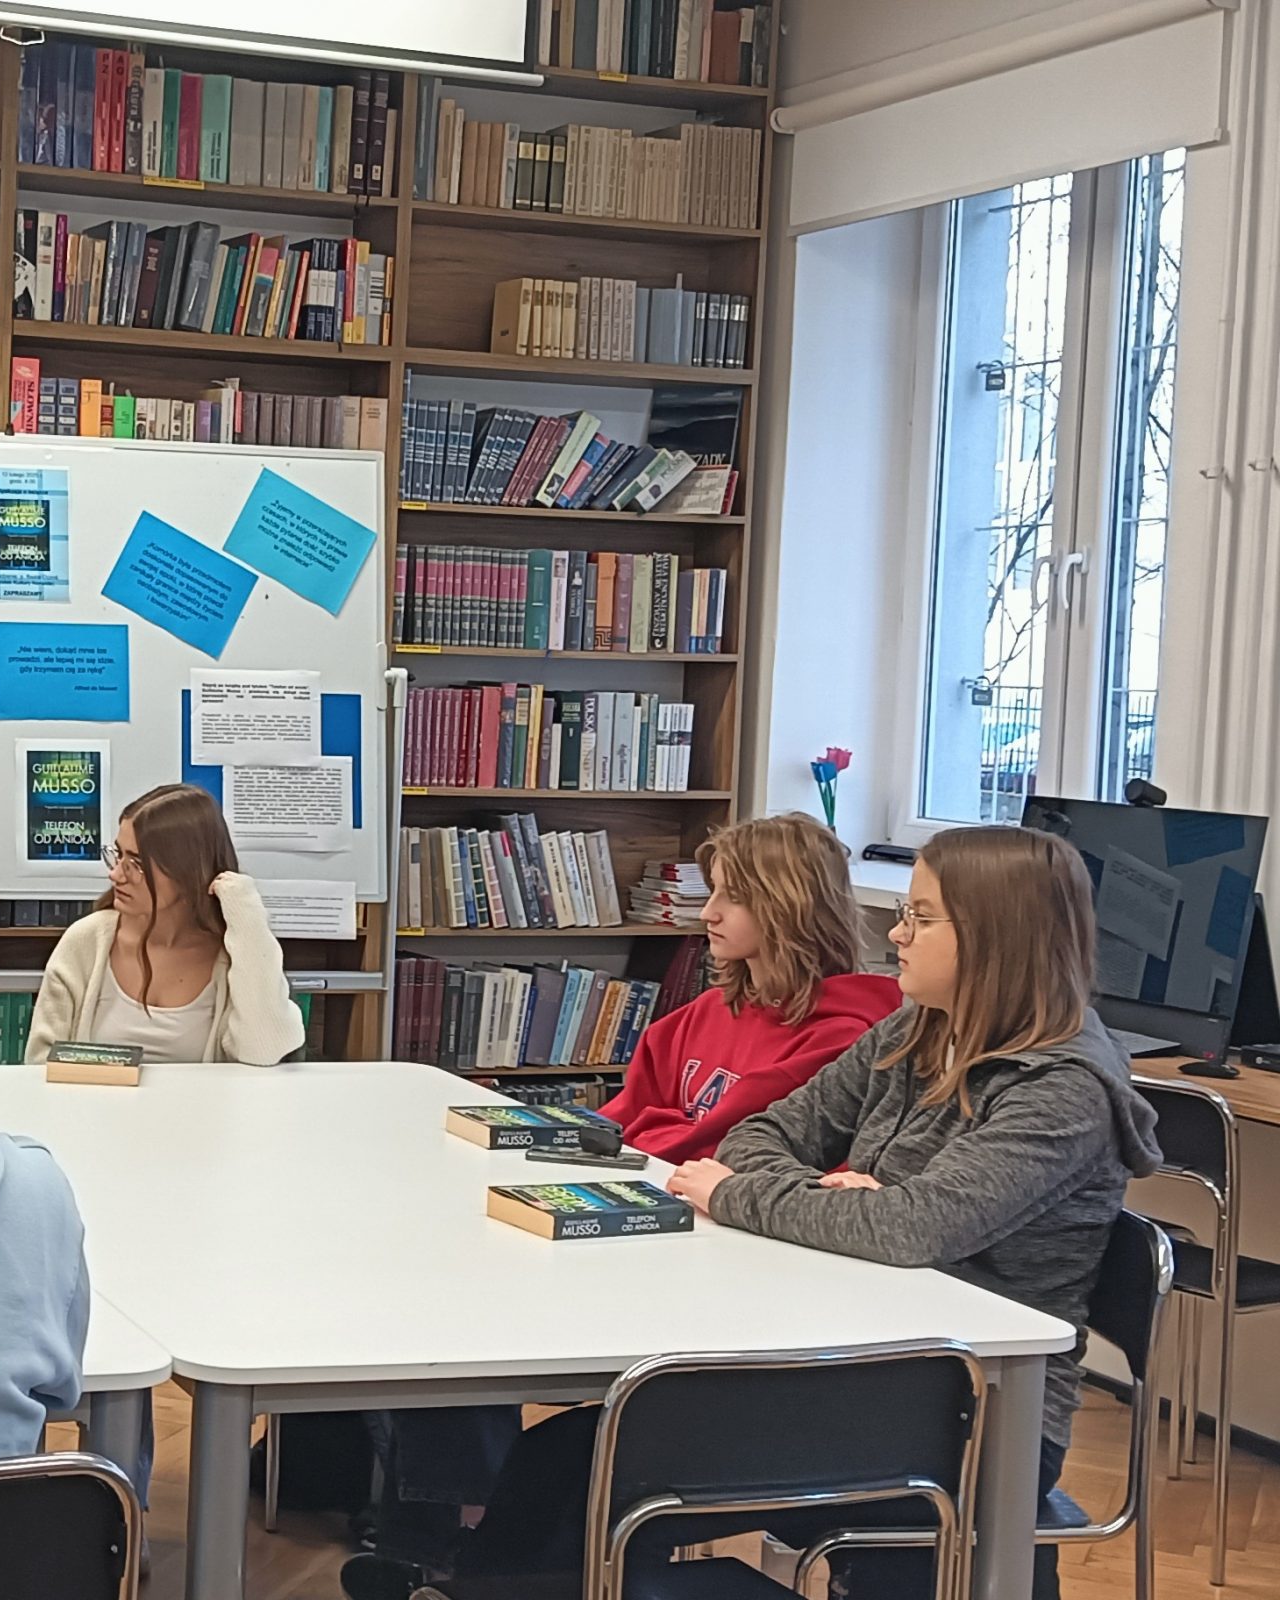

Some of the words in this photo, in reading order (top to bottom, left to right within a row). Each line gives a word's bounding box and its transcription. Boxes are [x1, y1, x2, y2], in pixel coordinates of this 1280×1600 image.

[261, 516, 281, 530] każde
[279, 527, 303, 544] pytanie
[318, 549, 341, 565] szybko
[295, 525, 319, 542] których
[327, 543, 348, 559] prawie
[301, 518, 348, 548] przerażających
[0, 552, 13, 560] OD
[15, 552, 46, 561] ANIOŁA
[7, 544, 38, 553] TELEFON
[257, 524, 280, 540] można
[302, 550, 336, 573] odpowiedź
[141, 549, 175, 571] doskonale
[174, 567, 219, 596] dopasowanym
[219, 592, 229, 601] do
[177, 558, 192, 571] była
[192, 566, 233, 592] przedmiotem
[654, 553, 662, 589] KULTURY
[661, 553, 669, 576] MAŁA
[128, 564, 155, 582] zanikały
[155, 579, 179, 596] granice
[178, 591, 202, 609] między
[137, 558, 159, 574] swojej
[184, 583, 204, 599] której
[170, 597, 210, 622] zawodowym
[652, 591, 660, 637] ANTYCZNEJ
[659, 578, 668, 637] ENCYKLOPEDIA
[19, 666, 32, 674] gdy
[33, 666, 64, 674] trzymam
[65, 667, 76, 675] cię
[585, 697, 596, 734] POLSKA
[32, 763, 95, 775] GUILLAUME
[32, 779, 95, 794] MUSSO
[45, 821, 85, 831] TELEFON
[34, 834, 52, 844] OD
[54, 834, 95, 844] ANIOŁA
[497, 1136, 534, 1146] MUSSO
[561, 1224, 601, 1236] MUSSO
[621, 1224, 634, 1232] OD
[634, 1223, 660, 1231] ANIOŁA
[626, 1215, 656, 1223] TELEFON
